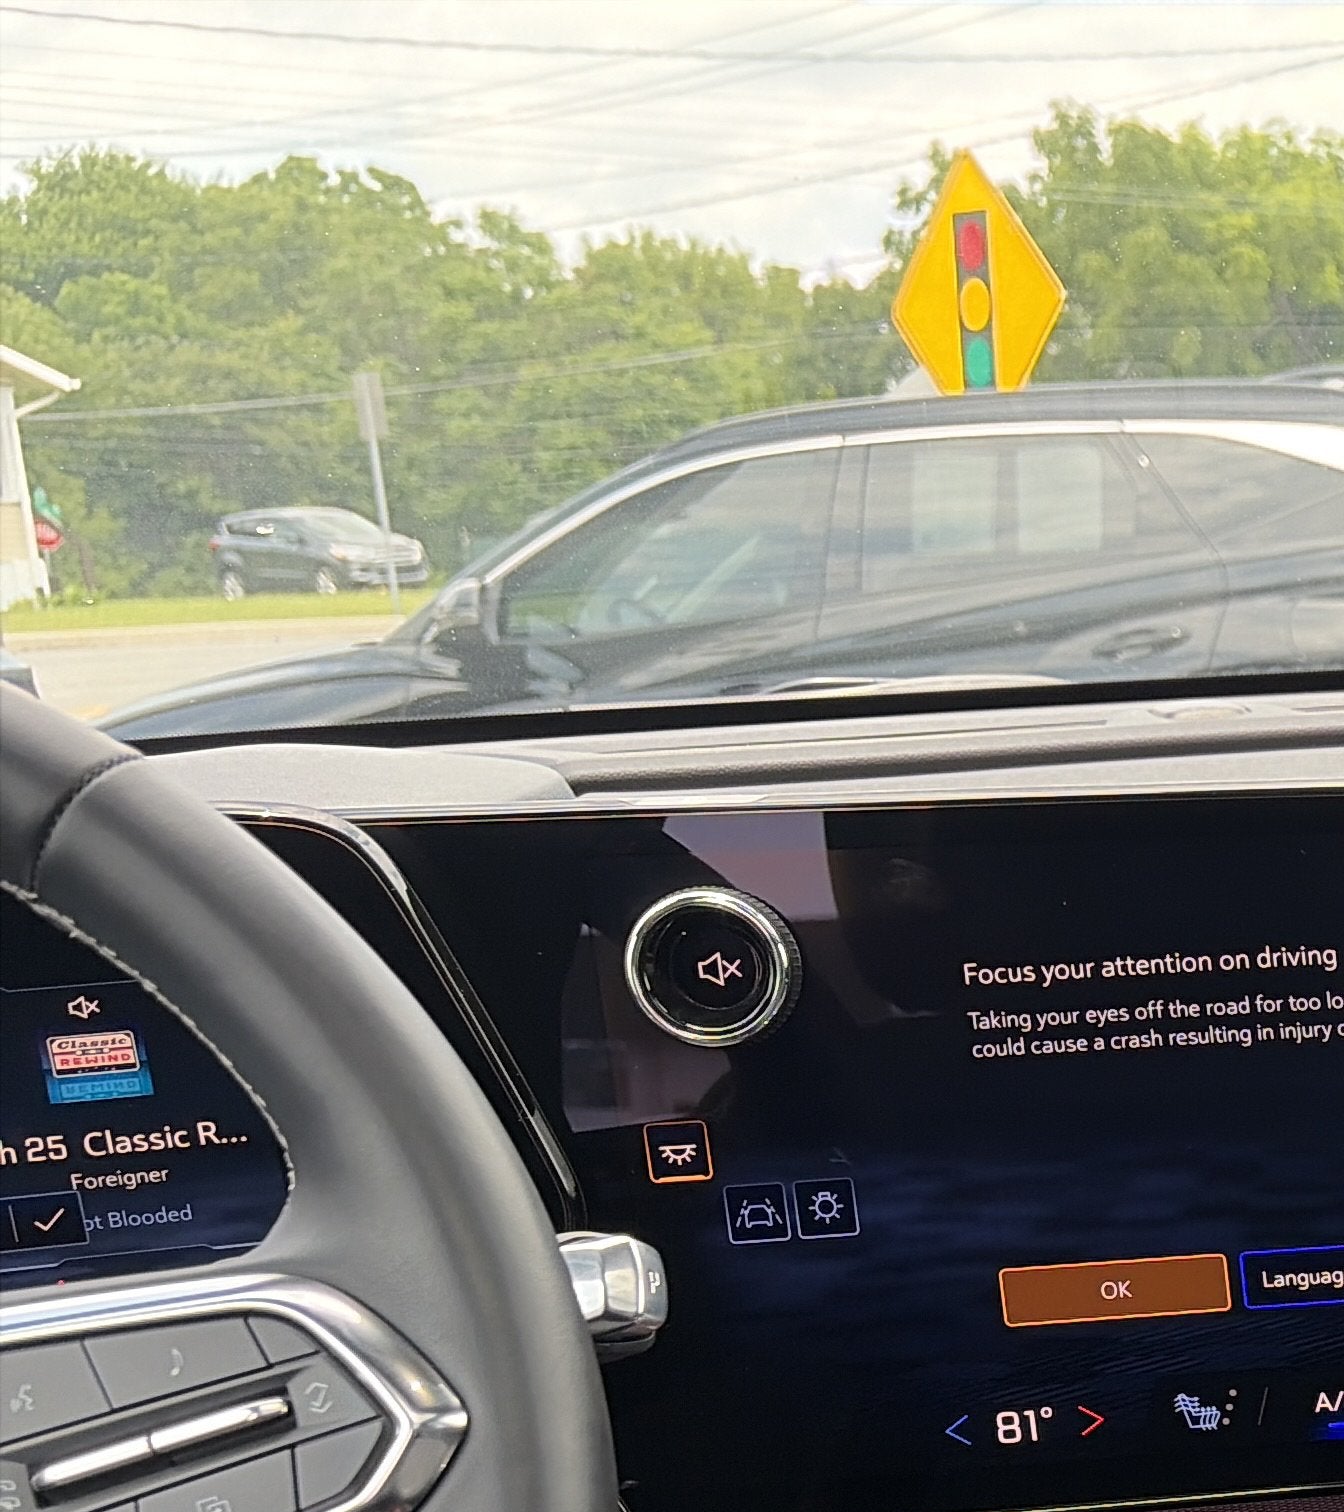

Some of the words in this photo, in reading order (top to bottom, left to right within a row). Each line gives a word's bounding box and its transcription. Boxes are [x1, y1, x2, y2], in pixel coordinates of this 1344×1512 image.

[963, 962, 1036, 986] Focus
[1041, 961, 1096, 988] your
[1101, 952, 1213, 978] attention
[1219, 953, 1250, 971] on
[1256, 944, 1338, 972] driving
[967, 1009, 1032, 1033] Taking
[1035, 1009, 1080, 1032] your
[1085, 1007, 1130, 1028] eyes
[1134, 1000, 1165, 1021] off
[1168, 999, 1201, 1019] the
[1205, 995, 1251, 1017] road
[1255, 993, 1284, 1014] for
[1287, 995, 1322, 1012] too
[56, 1037, 128, 1050] Classic
[972, 1036, 1026, 1059] could
[1030, 1037, 1089, 1056] cause
[1093, 1036, 1106, 1051] a
[1110, 1027, 1164, 1050] crash
[1168, 1023, 1253, 1048] resulting
[1256, 1023, 1276, 1042] in
[1279, 1020, 1334, 1044] injury
[60, 1053, 132, 1067] REWIND
[0, 1140, 18, 1165] h
[24, 1135, 68, 1162] 25
[83, 1125, 191, 1157] Classic
[196, 1121, 249, 1146] R...
[70, 1169, 169, 1190] Foreigner
[84, 1214, 105, 1232] ot
[107, 1203, 193, 1230] Blooded
[1100, 1279, 1133, 1300] OK
[996, 1406, 1054, 1444] 81°
